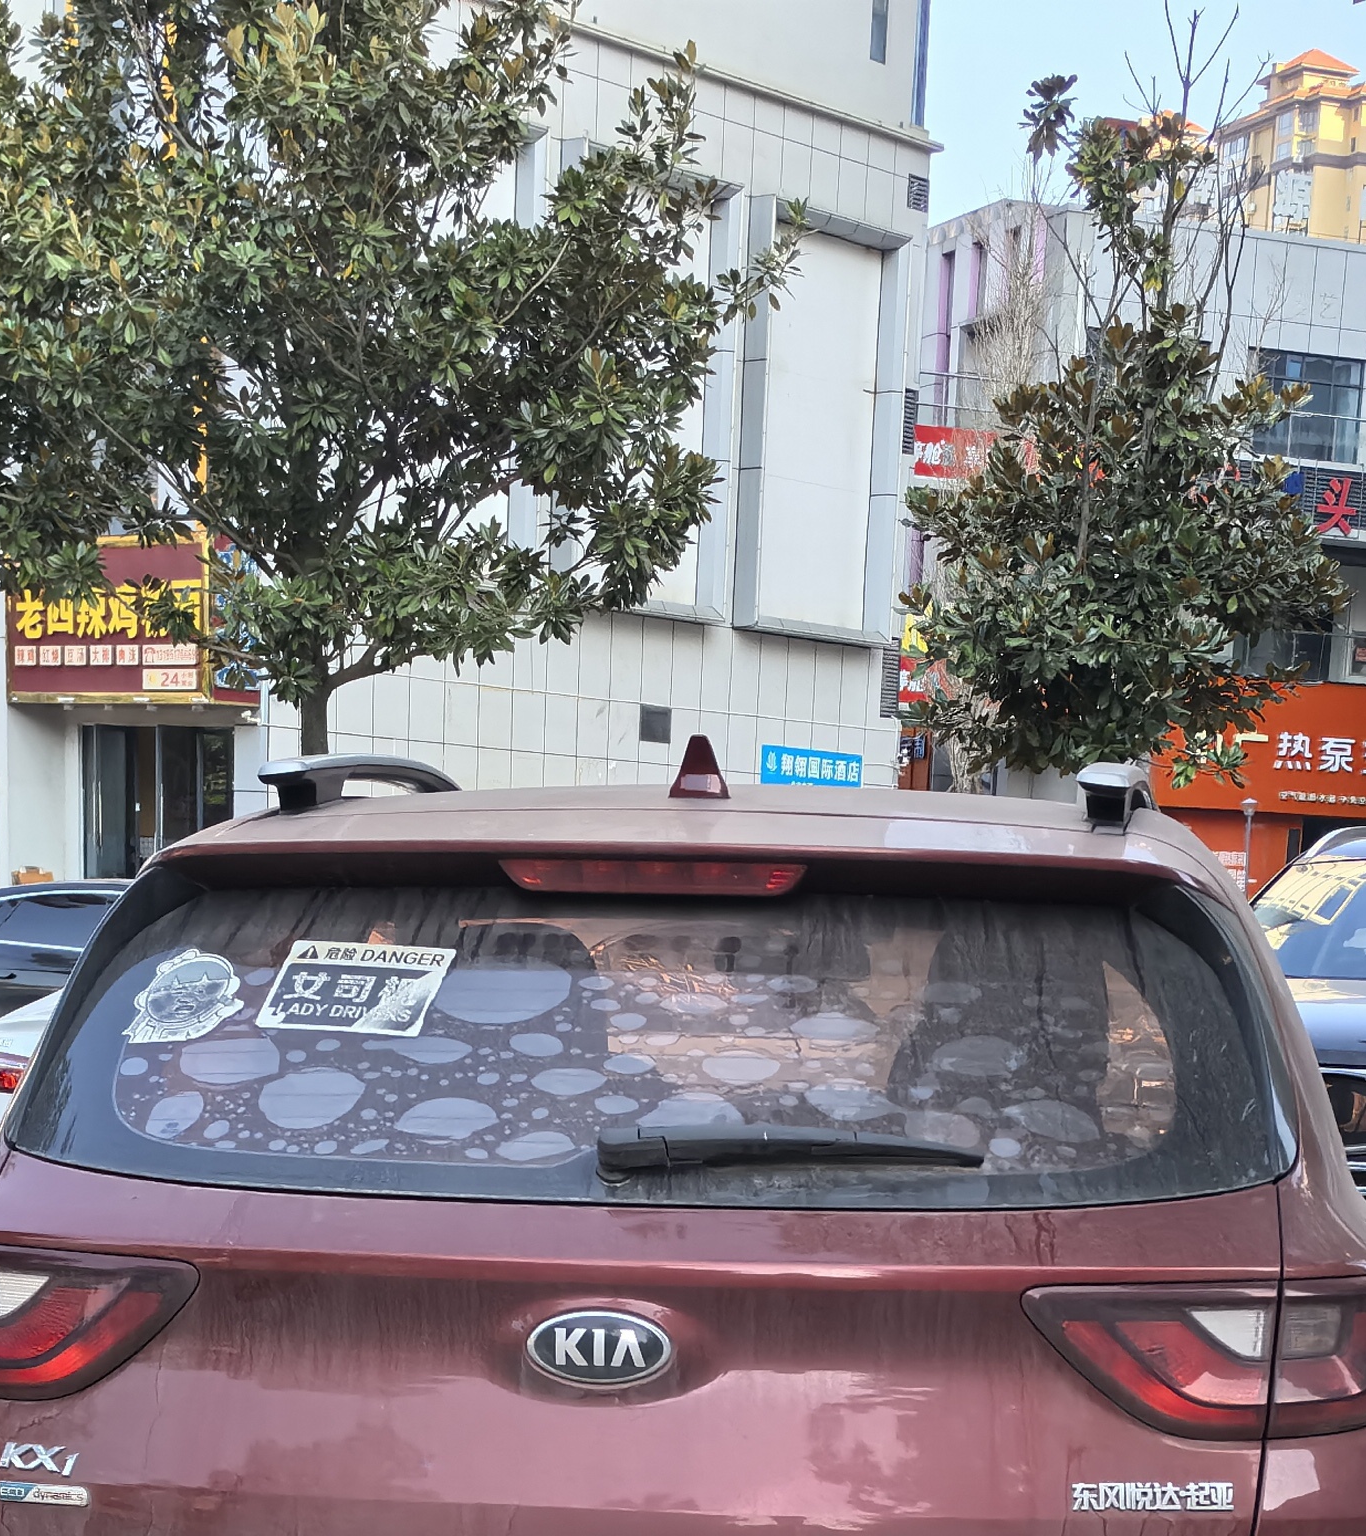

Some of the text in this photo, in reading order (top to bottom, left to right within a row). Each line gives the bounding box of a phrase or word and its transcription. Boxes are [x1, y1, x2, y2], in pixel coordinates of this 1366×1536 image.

[160, 671, 180, 687] 24
[323, 946, 445, 967] 危险 DANGER
[282, 971, 418, 1006] 女司机
[276, 1002, 329, 1017] LADY
[554, 1327, 647, 1368] KIA
